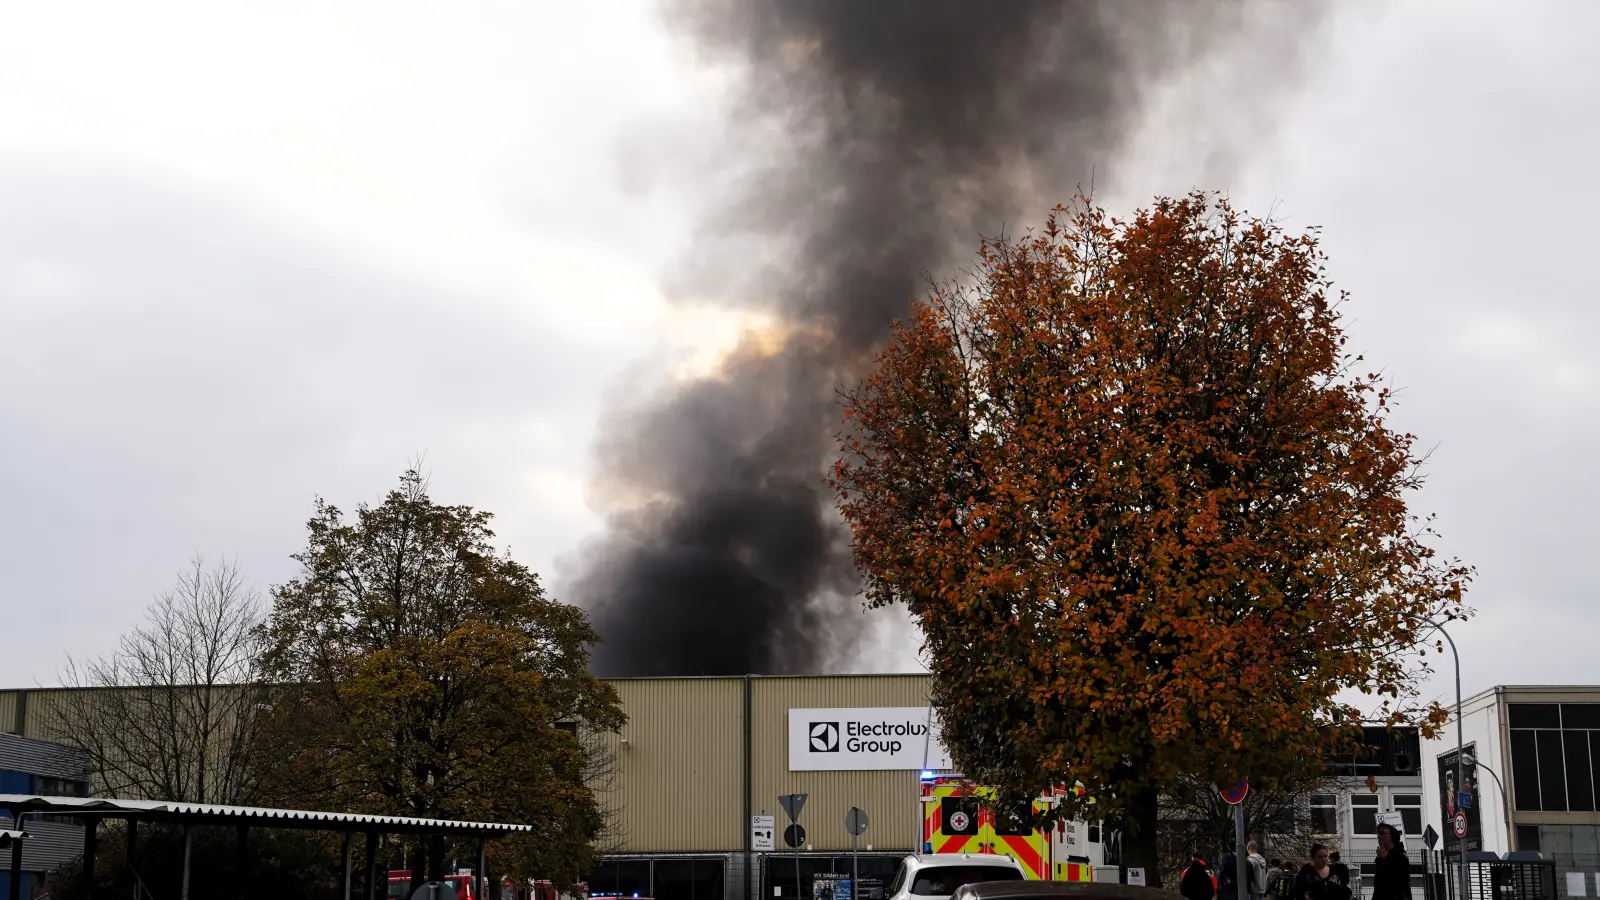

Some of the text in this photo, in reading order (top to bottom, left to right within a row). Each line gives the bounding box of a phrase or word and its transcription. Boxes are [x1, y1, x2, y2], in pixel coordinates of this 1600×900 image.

[847, 721, 930, 736] Electrolux
[847, 737, 902, 756] Group
[1456, 819, 1464, 830] 30
